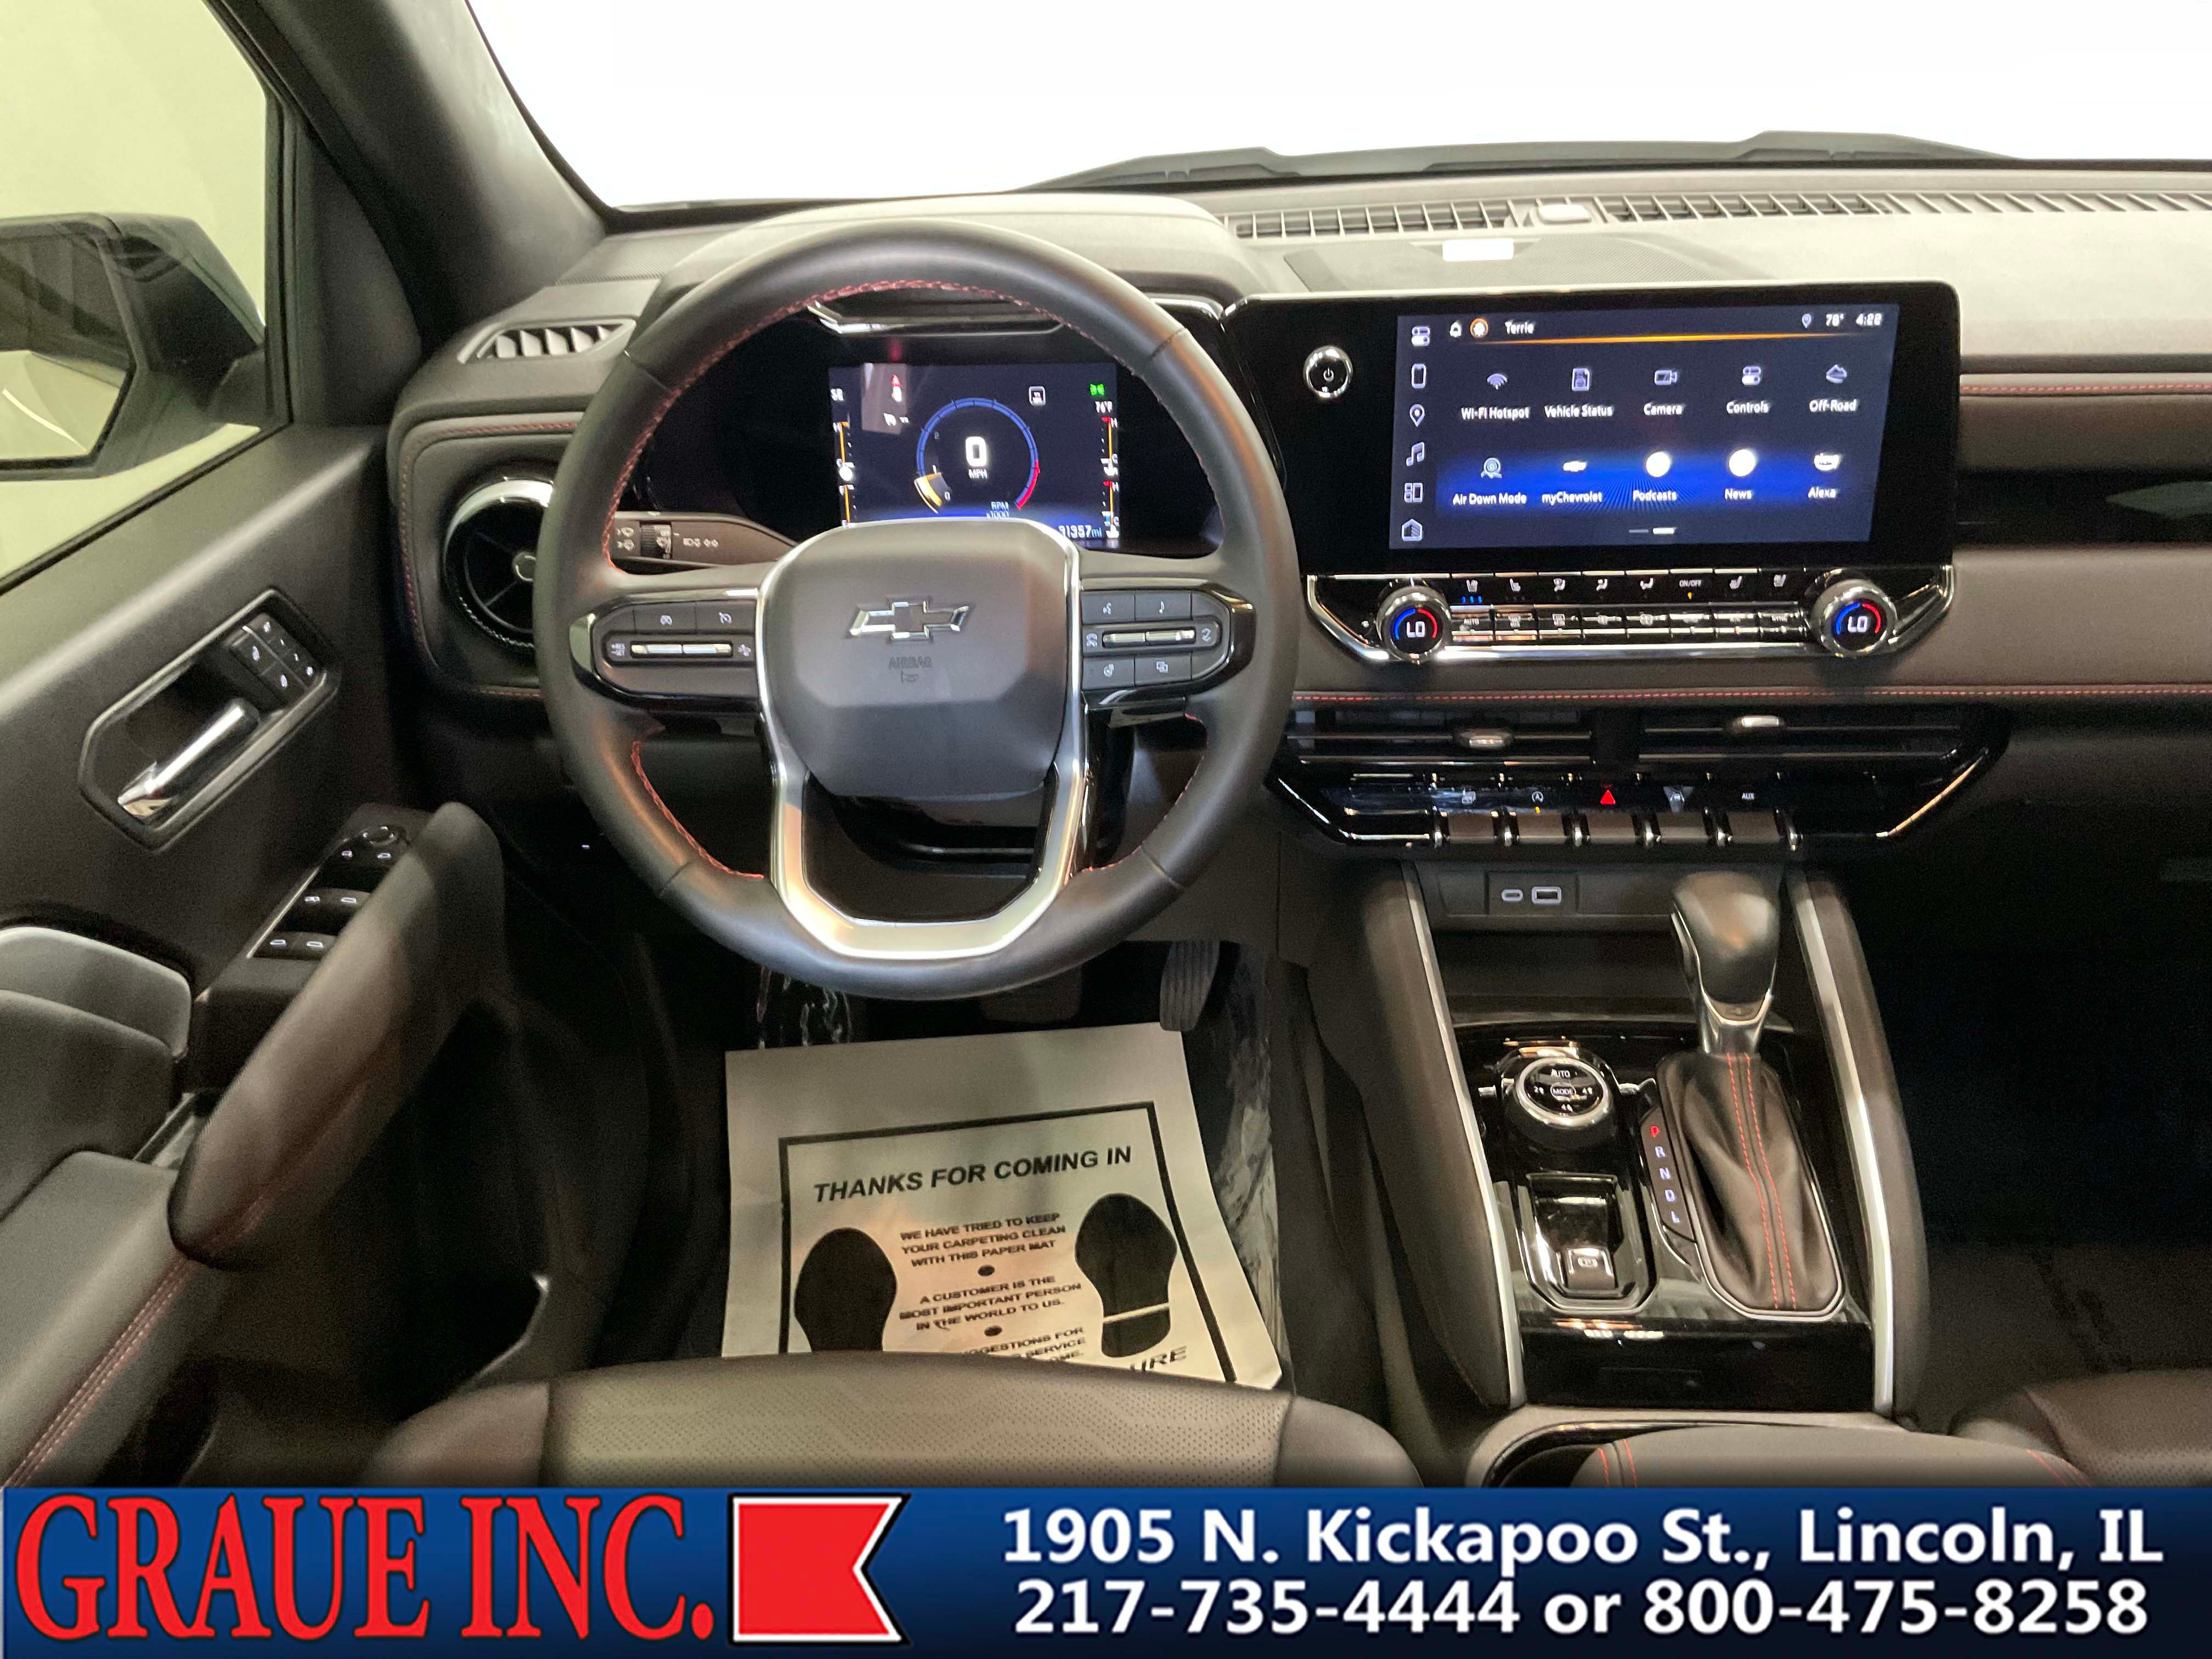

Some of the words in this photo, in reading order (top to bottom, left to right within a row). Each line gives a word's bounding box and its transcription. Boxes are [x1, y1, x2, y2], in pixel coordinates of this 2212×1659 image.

[1505, 320, 1534, 334] Terrie
[1544, 405, 1579, 417] Vehicle
[1581, 404, 1613, 417] Status
[1644, 403, 1683, 415] Camera
[1726, 401, 1770, 414] Controls
[1809, 399, 1858, 413] Off-Road
[1461, 407, 1487, 420] Wi-Fi
[1489, 406, 1530, 421] Hotspot
[966, 436, 987, 466] 0
[968, 469, 988, 479] MPH
[1453, 493, 1467, 505] Air
[1469, 493, 1497, 505] Down
[1499, 492, 1527, 504] Mode
[1542, 491, 1602, 506] myChevrolet
[1633, 489, 1677, 501] Podcasts
[1725, 488, 1752, 500] News
[1808, 487, 1836, 499] Alexa
[1406, 621, 1425, 638] LO
[1847, 616, 1868, 633] LO
[1741, 792, 1754, 800] AUX
[1551, 1069, 1570, 1078] AUTO
[1650, 1126, 1659, 1137] P
[1655, 1146, 1666, 1158] R
[814, 1172, 923, 1202] THANKS
[931, 1164, 985, 1188] FOR
[994, 1150, 1098, 1180] COMING
[1107, 1146, 1131, 1165] IN
[1659, 1167, 1671, 1180] N
[1664, 1189, 1675, 1201] D
[1671, 1211, 1680, 1223] L
[900, 1231, 921, 1240] WE
[925, 1226, 960, 1238] HAVE
[963, 1220, 1002, 1232] TRIED
[1005, 1216, 1023, 1227] TO
[1026, 1213, 1060, 1224] KEEP
[901, 1242, 939, 1254] YOUR
[943, 1232, 1019, 1250] CARPETING
[1022, 1225, 1066, 1238] CLEAN
[911, 1255, 945, 1267] WITH
[948, 1250, 978, 1262] THIS
[982, 1244, 1025, 1257] PAPER
[1029, 1240, 1056, 1251] MAT
[919, 1295, 931, 1304] A
[933, 1283, 1009, 1302] CUSTOMER
[1013, 1280, 1025, 1289] IS
[1028, 1276, 1056, 1286] THE
[899, 1307, 939, 1320] MOST
[943, 1293, 1023, 1313] IMPORTANT
[1025, 1283, 1081, 1299] PERSON
[916, 1322, 930, 1330] IN
[934, 1317, 961, 1328] THE
[964, 1307, 1016, 1322] WORLD
[1020, 1303, 1039, 1312] TO
[1042, 1299, 1064, 1308] US.
[1055, 1327, 1084, 1339] FOR
[1025, 1337, 1086, 1357] SERVICE
